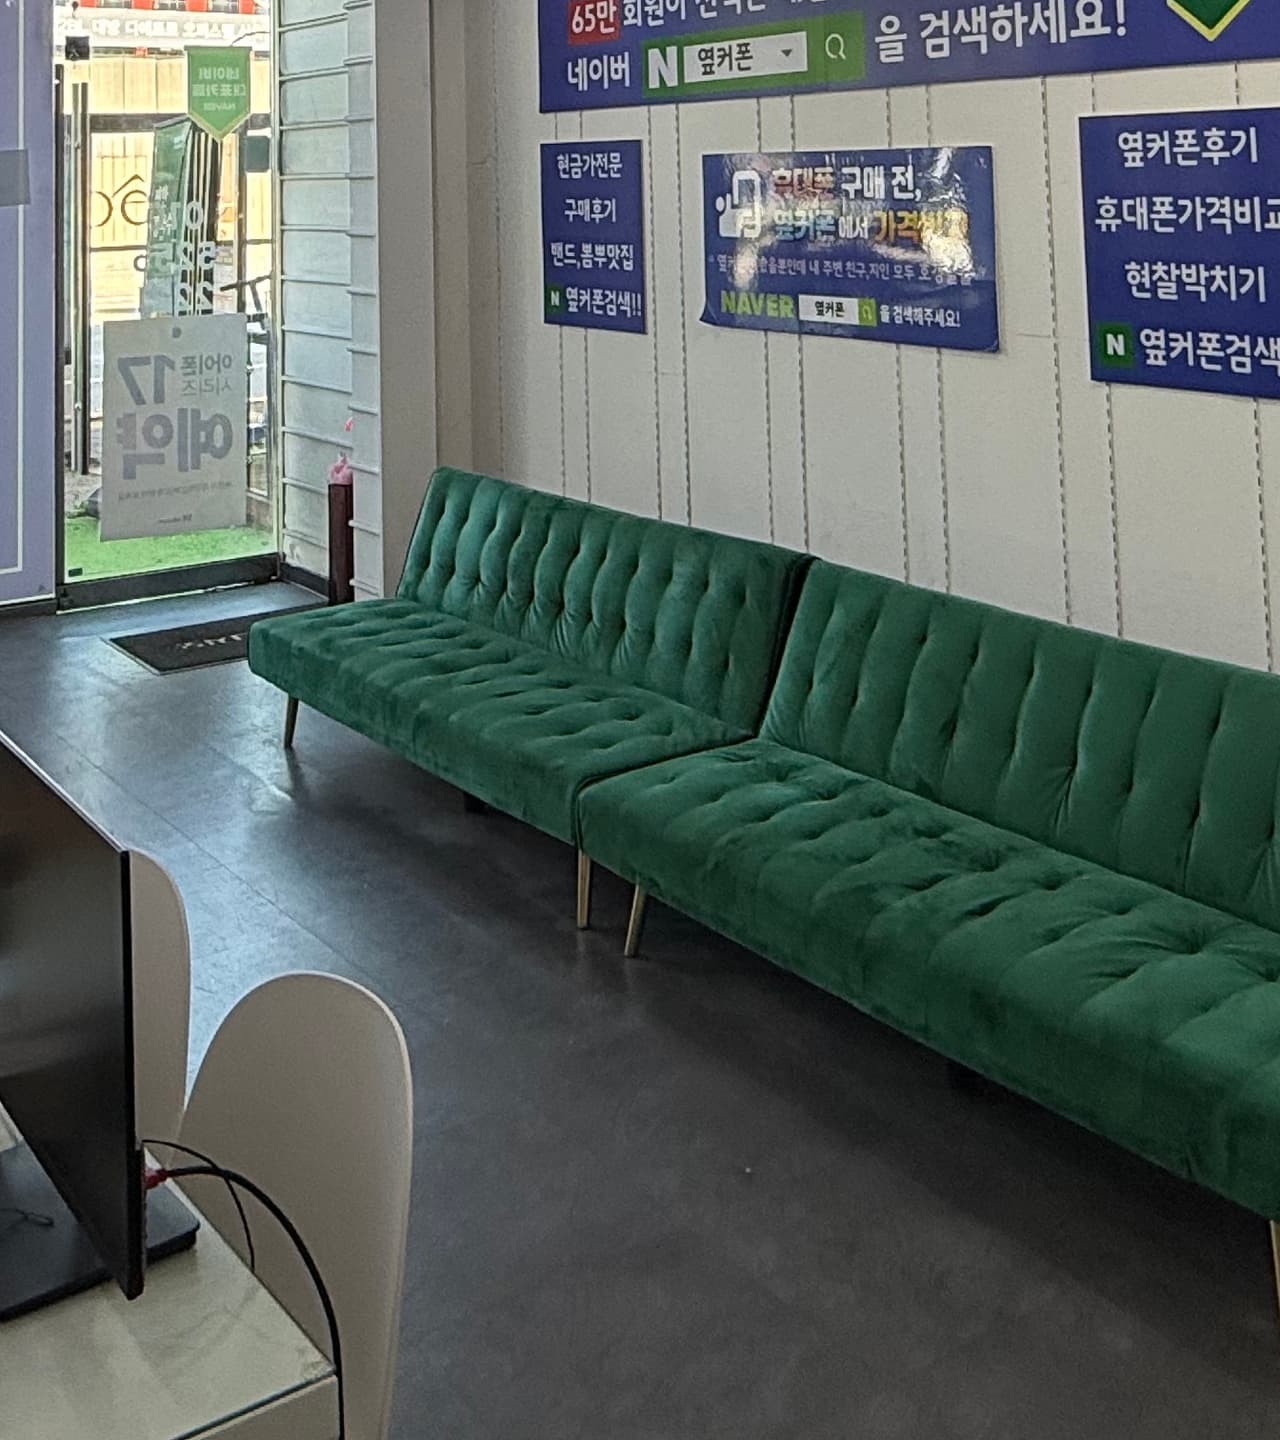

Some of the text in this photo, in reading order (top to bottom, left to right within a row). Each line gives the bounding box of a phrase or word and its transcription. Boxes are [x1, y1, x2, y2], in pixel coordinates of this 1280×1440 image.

[571, 0, 619, 36] 65만
[567, 55, 631, 92] 네이버
[646, 46, 678, 89] N
[696, 44, 754, 77] 옆커폰
[875, 17, 908, 62] 을
[556, 152, 623, 179] 현금가전문
[1118, 127, 1258, 168] 옆커폰후기
[772, 165, 922, 202] 휴대폰 구매 전,
[564, 197, 617, 224] 구매후기
[822, 259, 843, 278] 주변
[1124, 261, 1267, 303] 현찰박치기
[550, 286, 642, 318] N 옆커폰검색!!
[721, 290, 794, 319] NAVER
[814, 300, 846, 319] 옆커폰
[893, 306, 961, 328] 검색해주세요!
[1106, 333, 1125, 356] N
